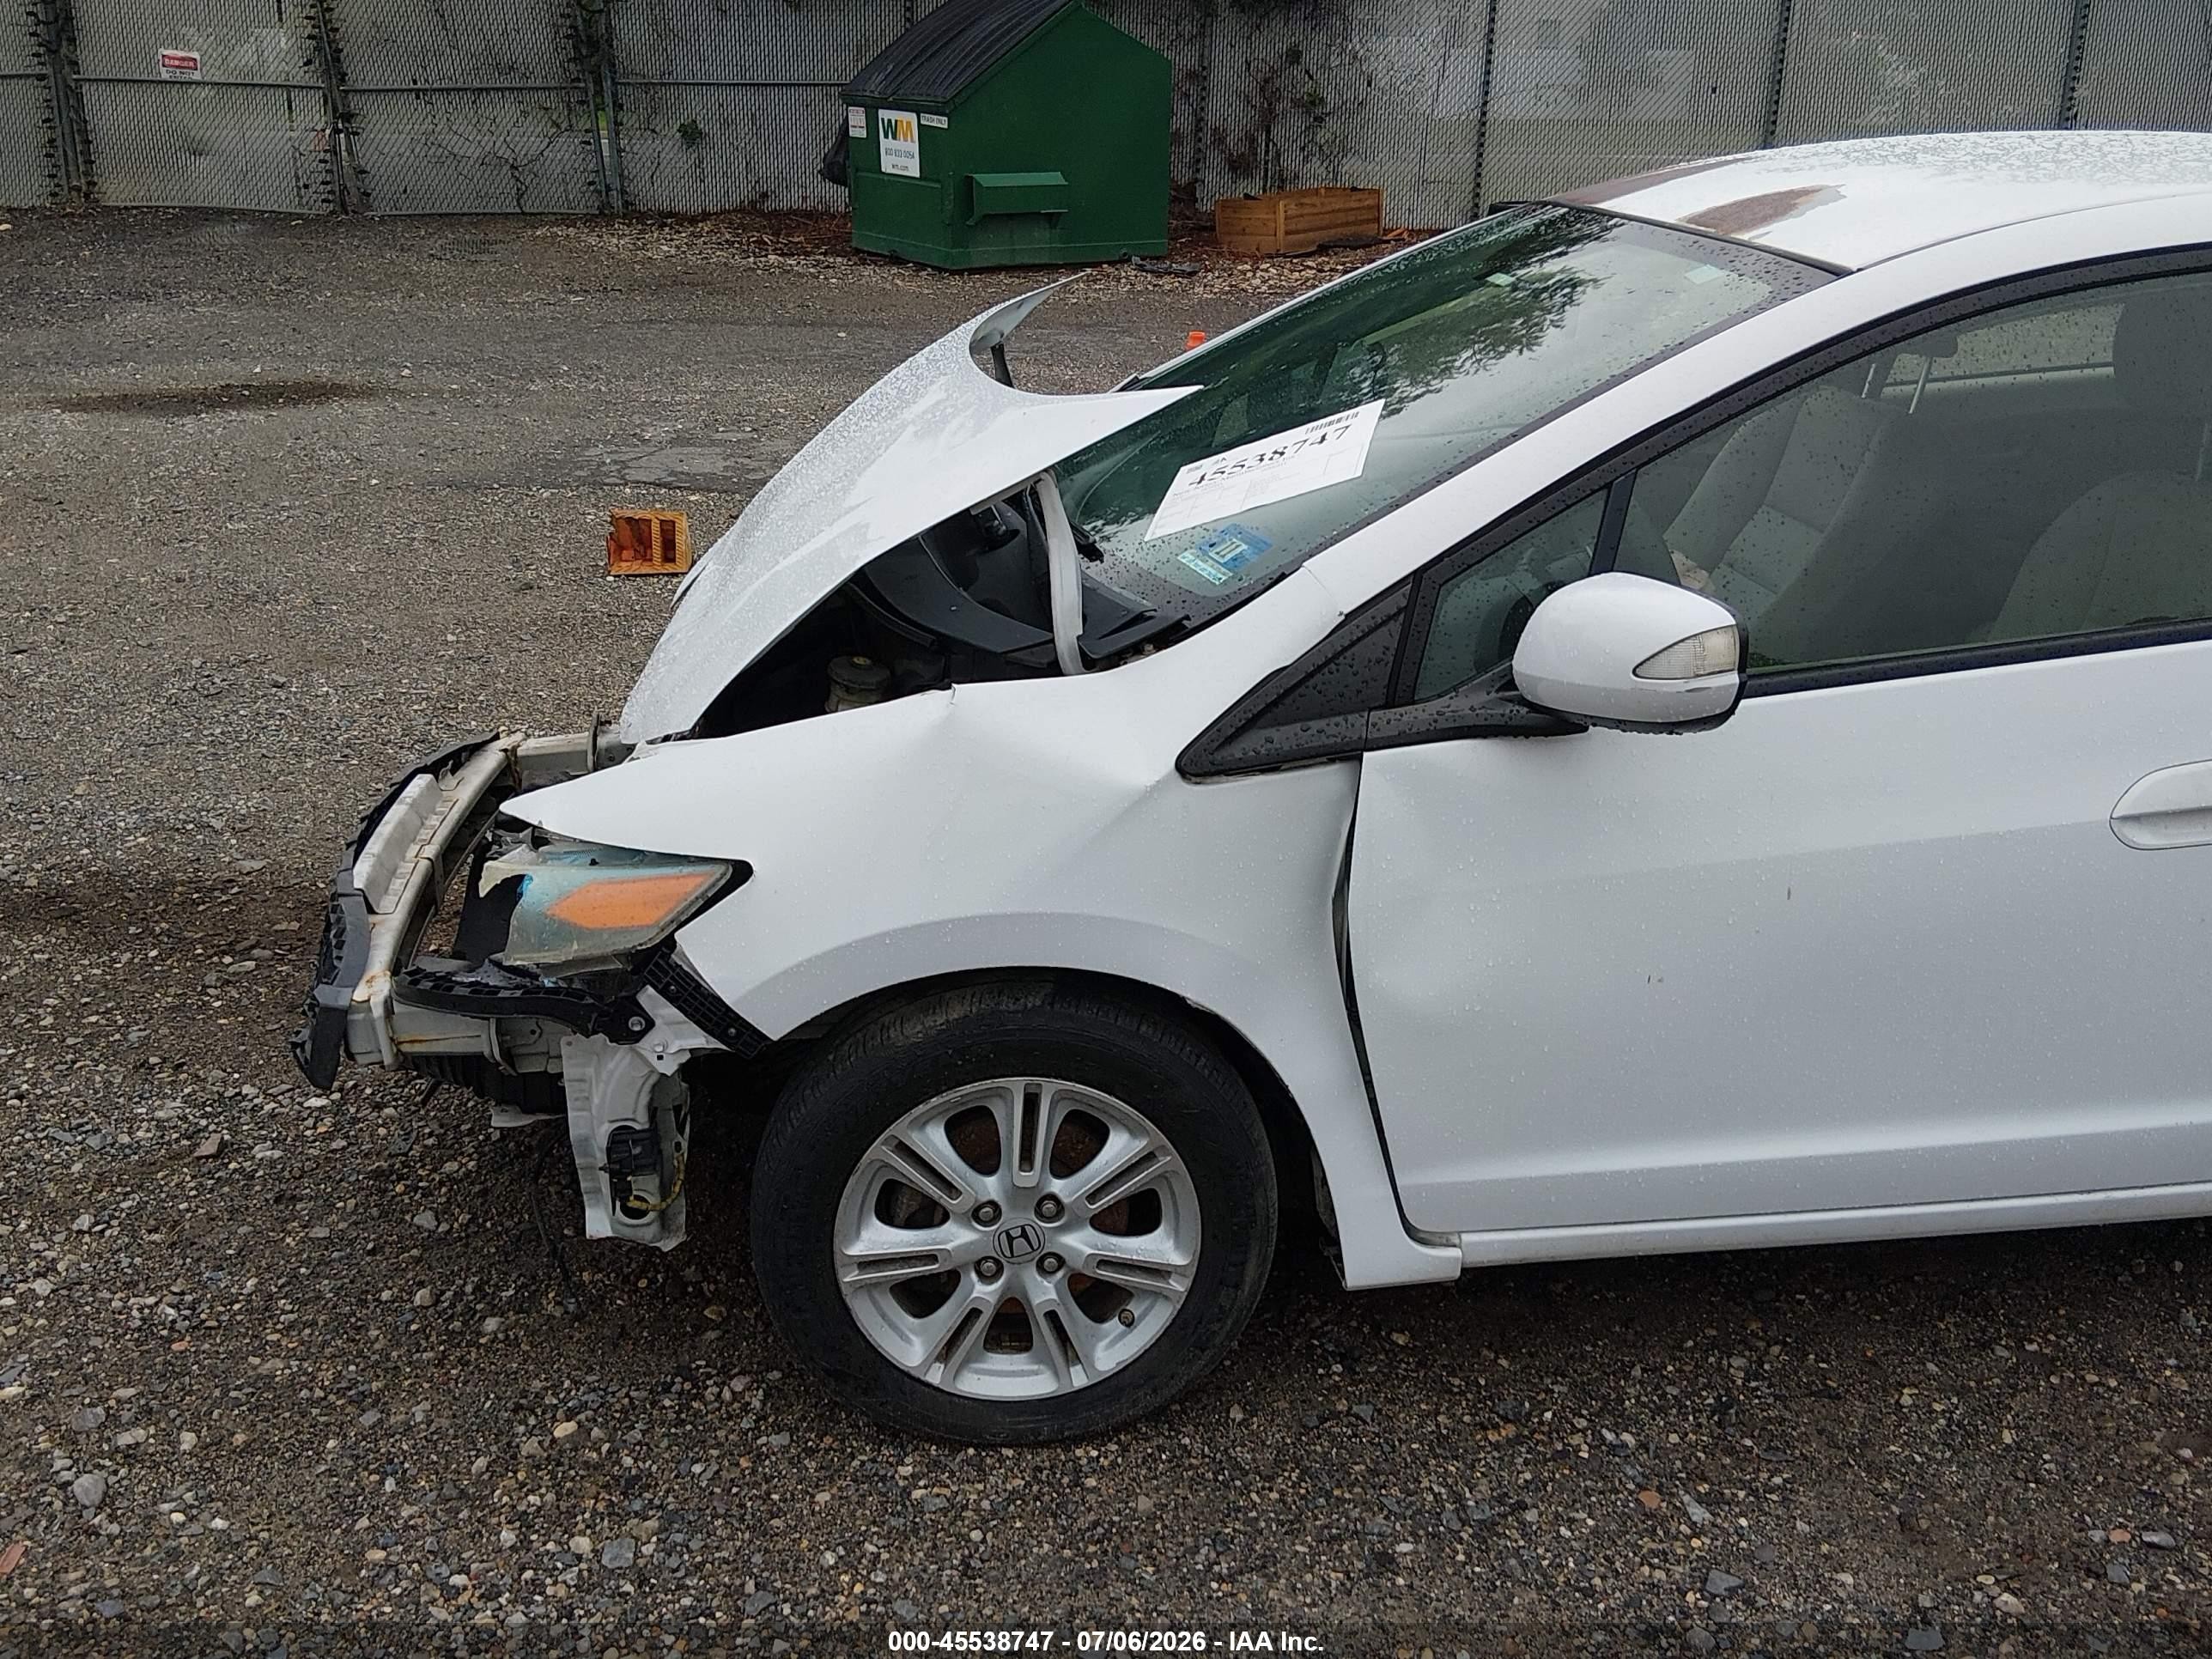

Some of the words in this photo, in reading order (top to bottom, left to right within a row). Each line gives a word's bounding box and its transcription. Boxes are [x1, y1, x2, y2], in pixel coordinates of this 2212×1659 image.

[164, 58, 196, 68] DANGER
[881, 117, 916, 143] WM
[1188, 423, 1352, 487] 45538747
